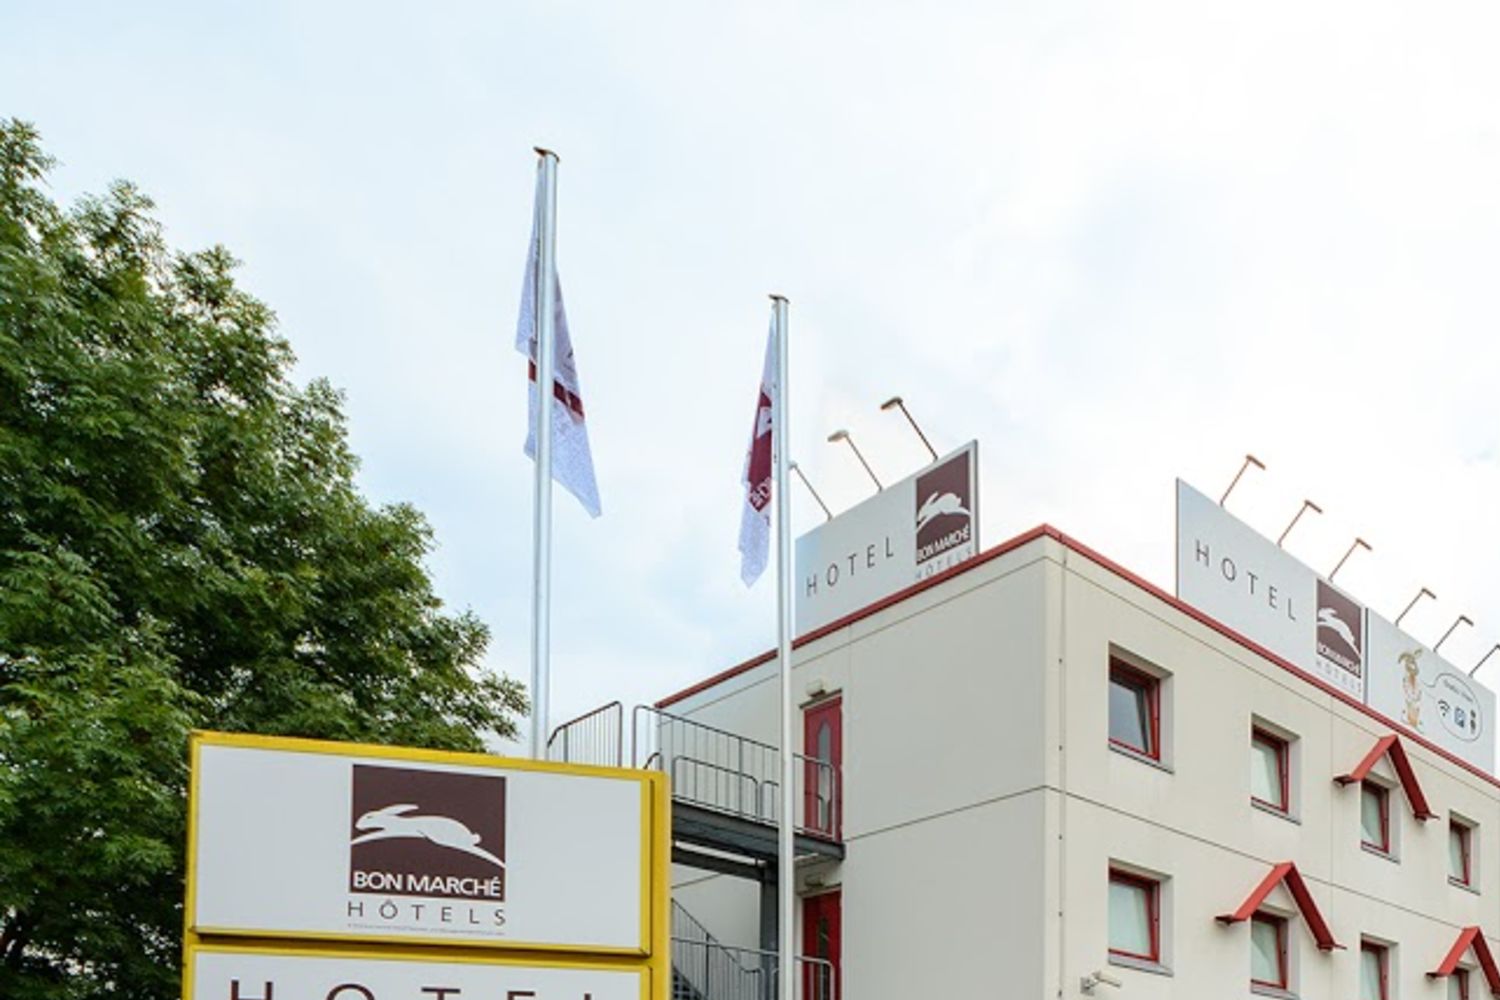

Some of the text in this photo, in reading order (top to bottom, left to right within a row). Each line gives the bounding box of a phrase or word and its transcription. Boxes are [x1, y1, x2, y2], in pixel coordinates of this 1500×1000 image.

[806, 537, 894, 597] HOTEL
[1195, 538, 1297, 621] HOTEL
[353, 871, 501, 897] BON MARCHÉ
[348, 900, 506, 926] HÔTELS
